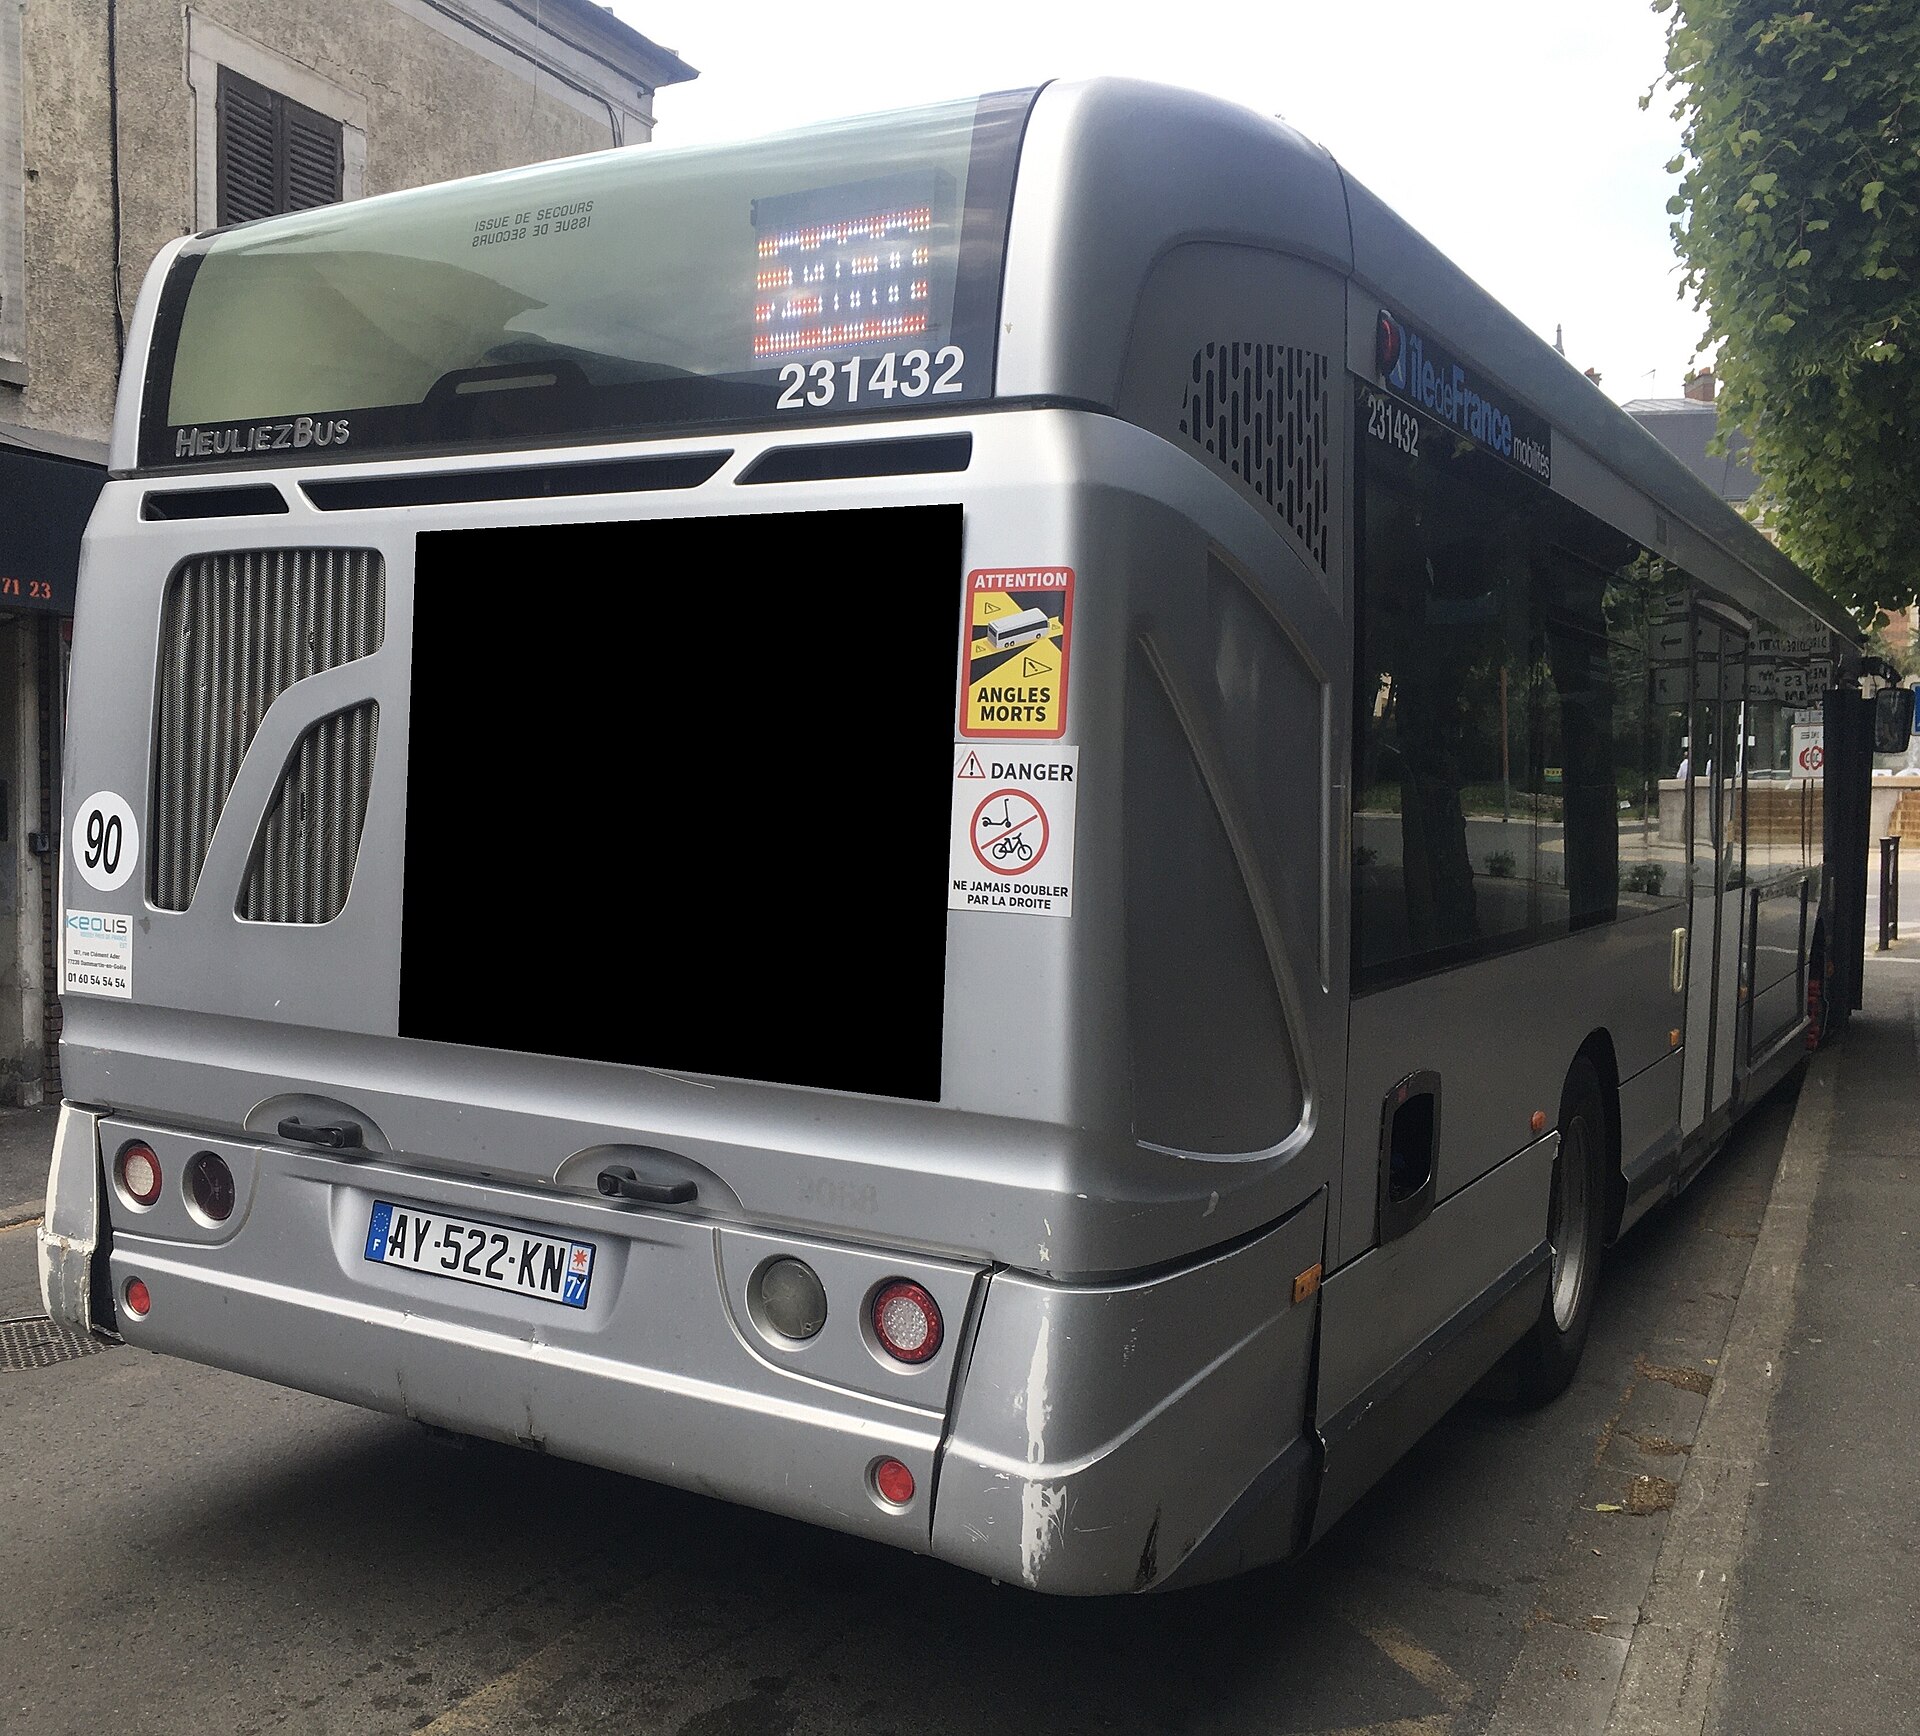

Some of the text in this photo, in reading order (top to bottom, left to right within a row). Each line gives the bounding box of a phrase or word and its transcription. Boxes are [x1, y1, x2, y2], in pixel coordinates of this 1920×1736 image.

[474, 200, 594, 232] ISSUE DE SECOURS
[776, 345, 965, 410] 231432
[1367, 395, 1419, 457] 231432
[2, 577, 52, 599] 71 23
[974, 572, 1067, 589] ATTENTION
[977, 687, 1051, 703] ANGLES
[980, 706, 1046, 722] MORTS
[991, 762, 1074, 781] DANGER
[84, 809, 123, 874] 90
[953, 880, 1069, 897] NE JAMAIS DOUBLER
[967, 894, 1051, 909] PAR LA DROITE
[68, 972, 126, 989] 01 60 54 54 54
[373, 1238, 382, 1252] F
[566, 1275, 587, 1300] 77
